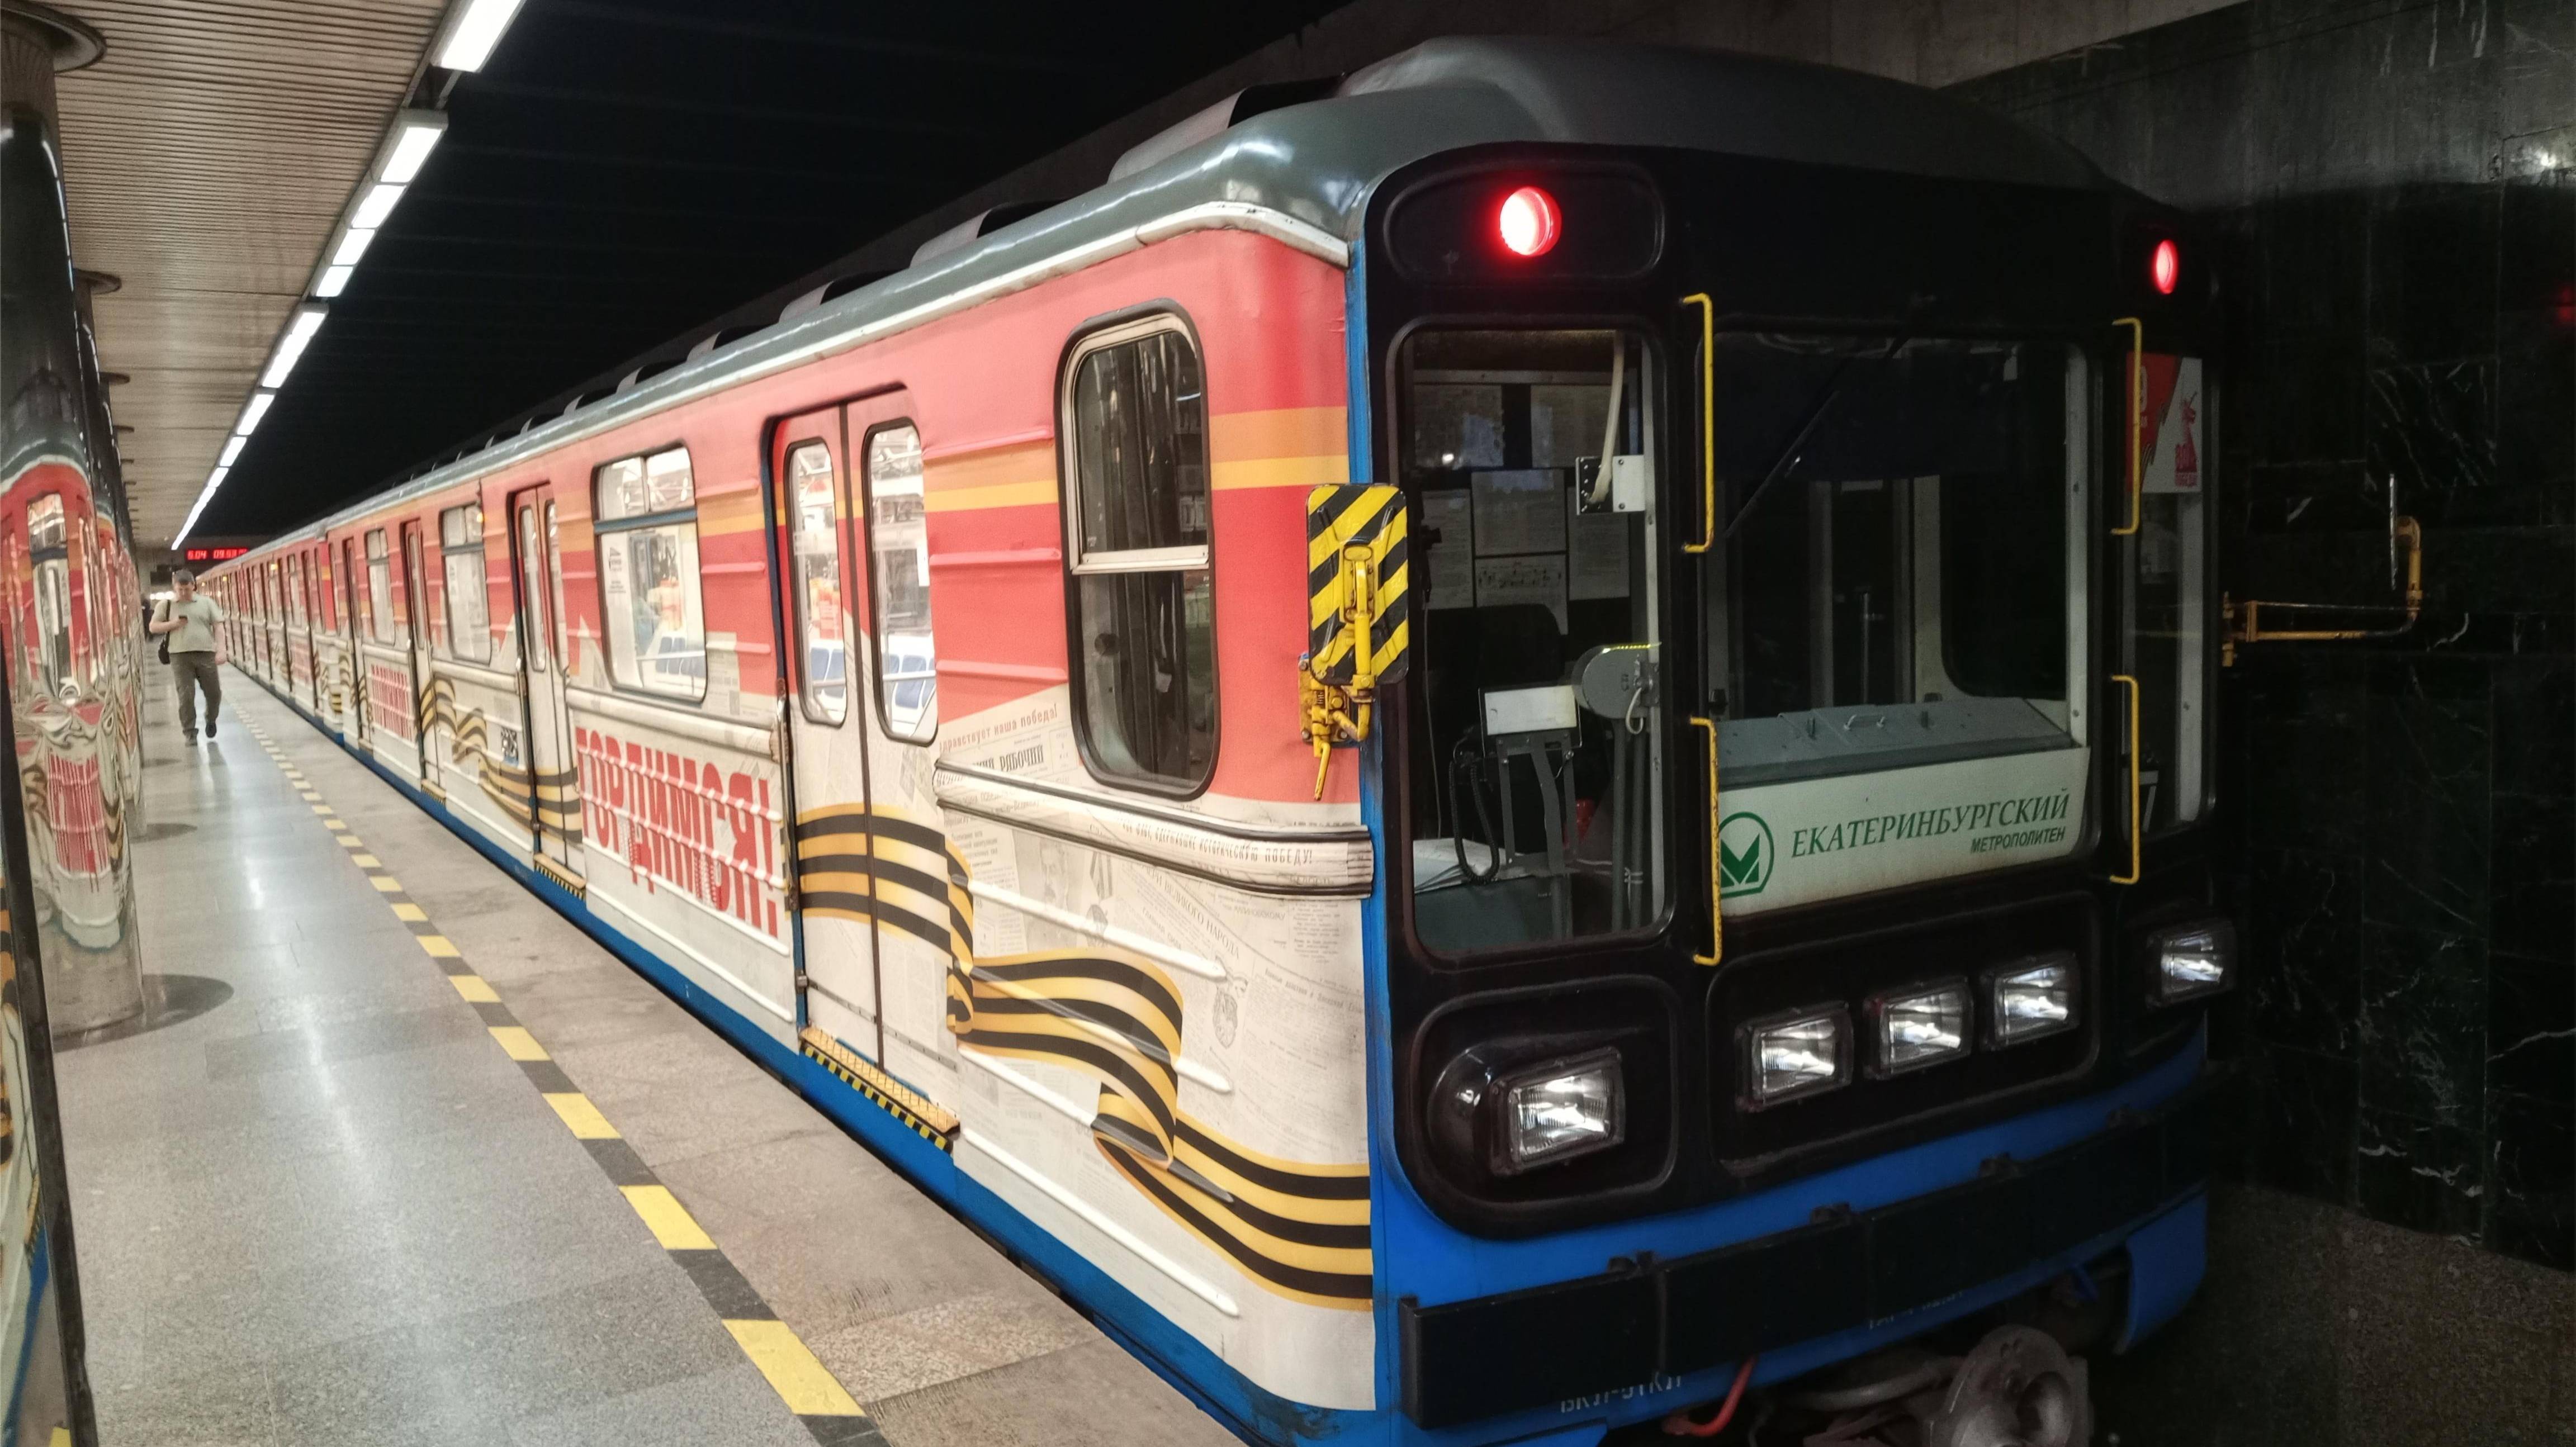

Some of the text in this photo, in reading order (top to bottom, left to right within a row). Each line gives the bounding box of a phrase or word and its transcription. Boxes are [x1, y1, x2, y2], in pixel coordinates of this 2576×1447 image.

[994, 719, 1017, 736] наша
[1021, 703, 1057, 727] победа!
[1000, 744, 1044, 772] РАБОЧИЙ
[575, 727, 778, 938] ГОРДИМСЯ!
[1791, 787, 2070, 857] ЕКАТЕРИНБУРГСКИЙ
[1971, 827, 2066, 853] МЕТРОПОЛИТЕН
[1265, 848, 1313, 866] ПОБЕДУ!
[1207, 919, 1239, 959] НАРОДА
